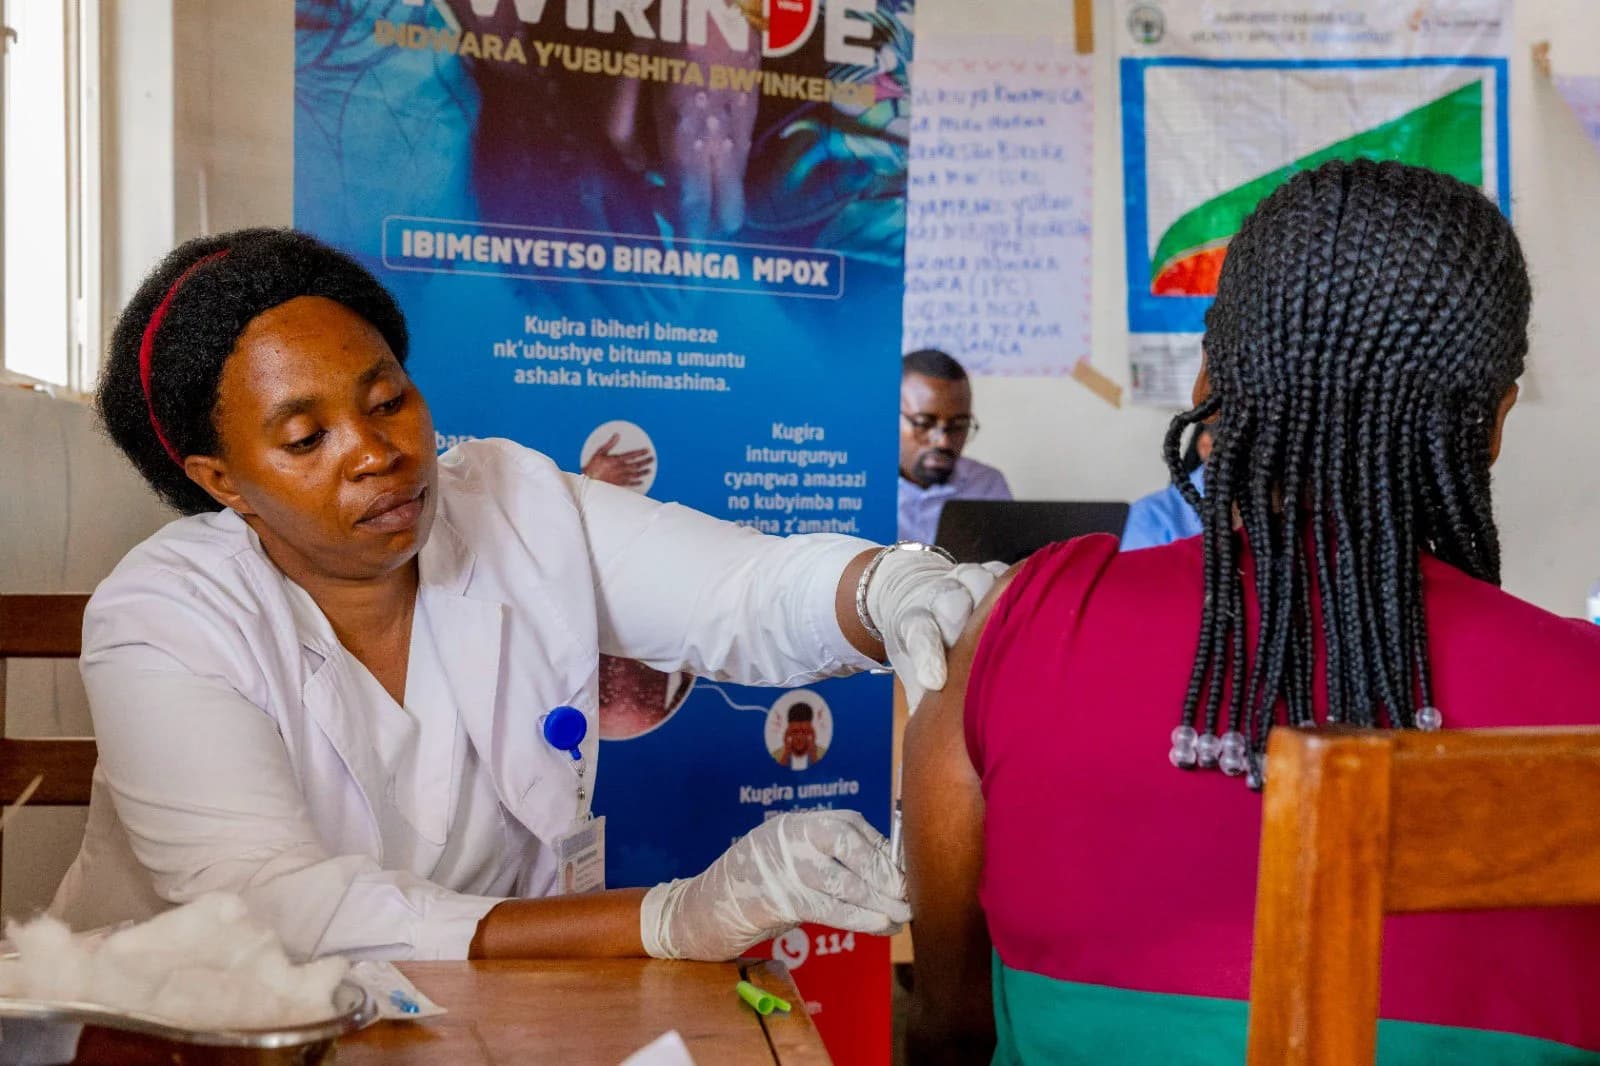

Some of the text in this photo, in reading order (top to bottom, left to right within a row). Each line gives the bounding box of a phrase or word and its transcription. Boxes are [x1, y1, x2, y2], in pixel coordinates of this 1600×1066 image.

[403, 0, 876, 67] RINDE
[374, 19, 527, 64] INDWARA
[533, 40, 704, 86] Y'UBUSHITA
[402, 229, 829, 287] IBIMENYETSO BIRANGA MPOX
[525, 315, 719, 344] Kugira ibiheri bimeze
[493, 339, 746, 369] nk'ubushye bituma umuntu
[514, 365, 731, 391] ashaka kwishimashima.
[772, 421, 826, 444] Kugira
[745, 444, 849, 468] inturugunyu
[723, 469, 867, 491] cyangwa amasazi
[728, 491, 863, 514] no kubyimba mu
[784, 515, 861, 533] z'amatwi.
[740, 778, 859, 806] Kugira umuriro
[816, 931, 856, 956] 114
